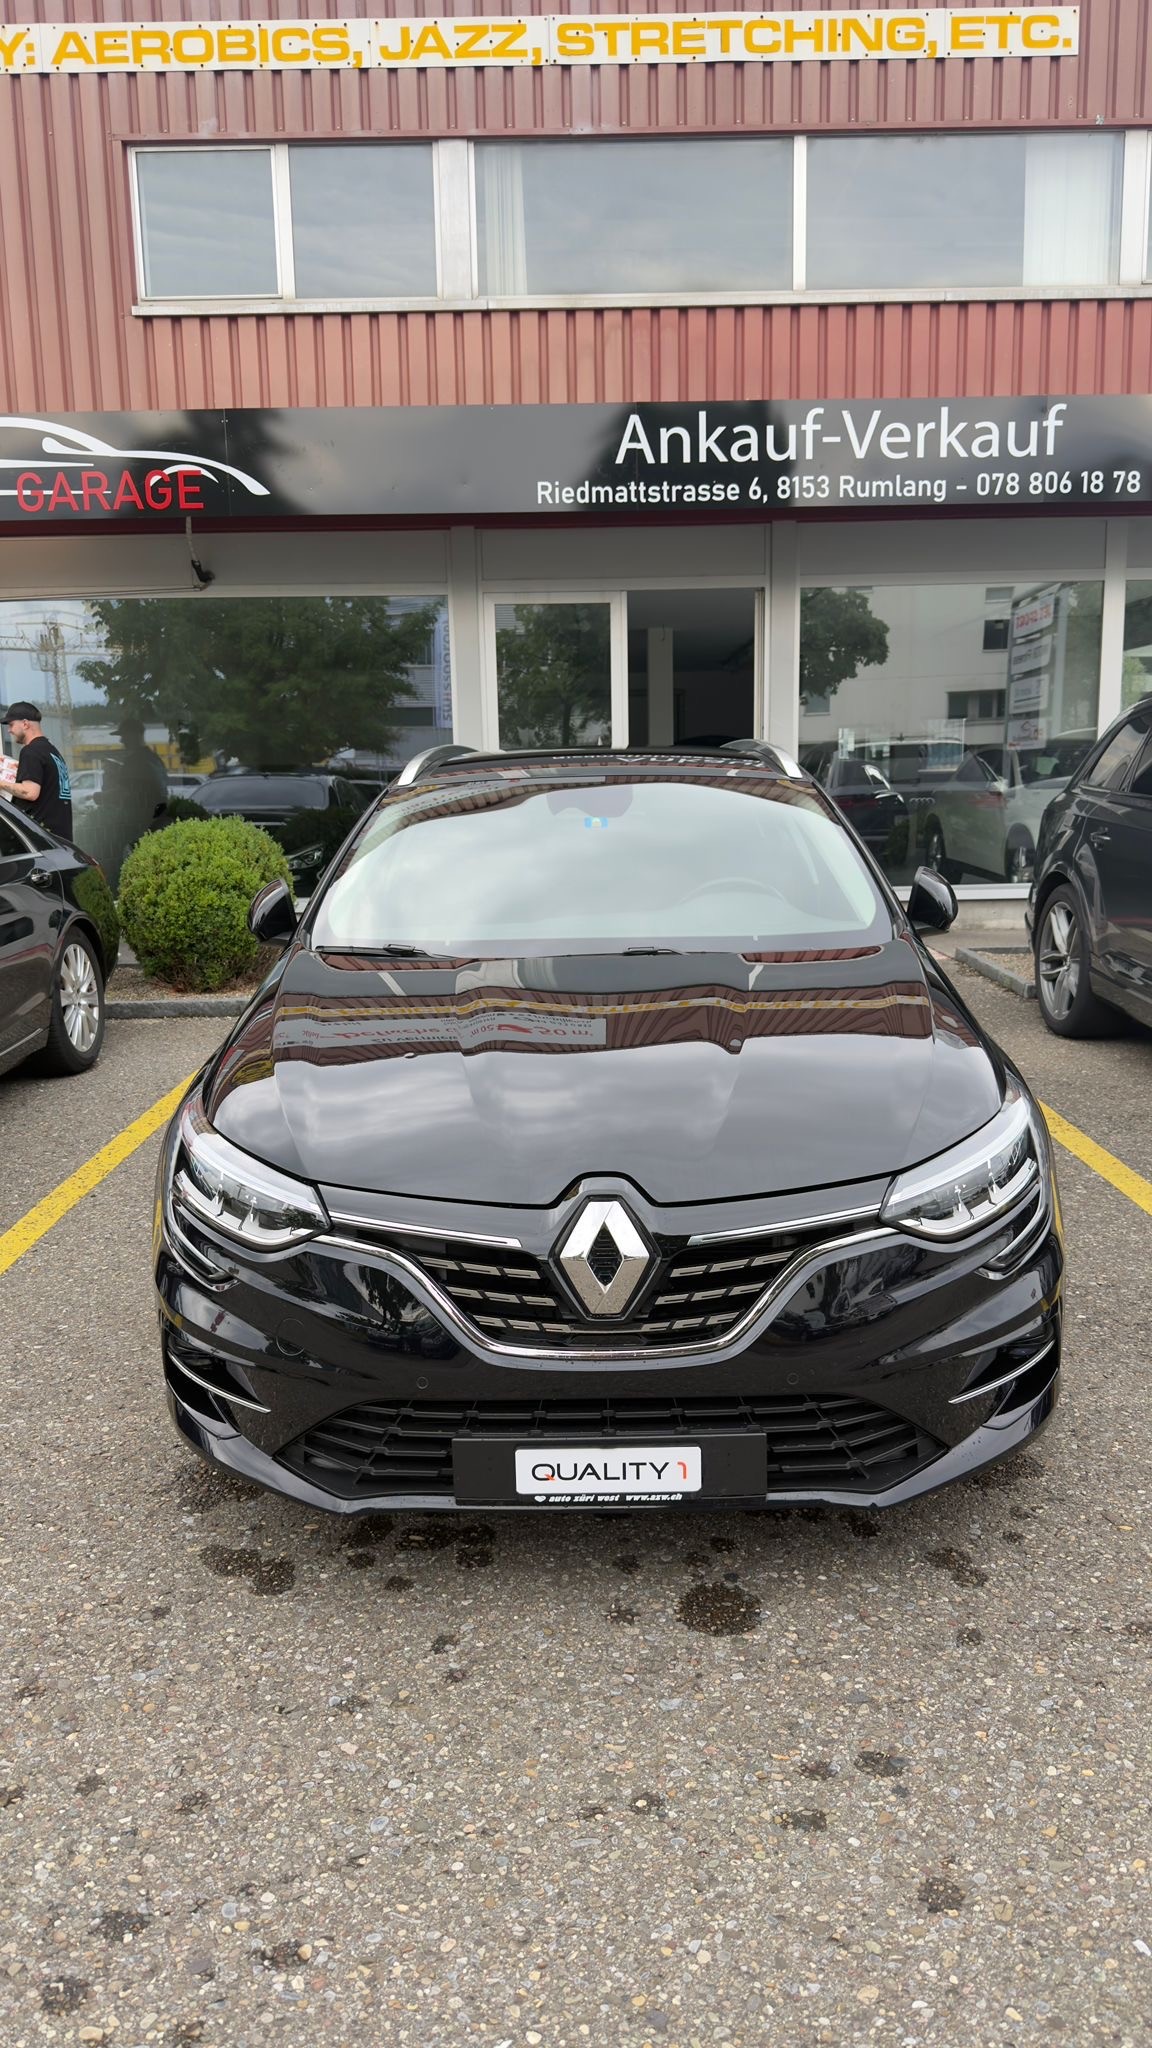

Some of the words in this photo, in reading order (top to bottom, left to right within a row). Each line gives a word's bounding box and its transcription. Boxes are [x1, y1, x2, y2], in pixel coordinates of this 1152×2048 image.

[51, 28, 363, 69] AEROBICS,
[379, 24, 542, 66] JAZZ,
[557, 18, 938, 59] STRETCHING,
[950, 15, 1072, 50] ETC.
[615, 403, 1068, 464] Ankauf-Verkauf
[16, 469, 205, 512] GARAGE
[537, 480, 740, 504] Riedmattstrasse
[748, 477, 769, 503] 6,
[777, 475, 830, 499] 8153
[839, 474, 947, 502] Rumlang
[976, 472, 1020, 496] 078
[1028, 471, 1073, 495] 806
[1081, 471, 1104, 494] 18
[1112, 470, 1142, 494] 78
[531, 1461, 670, 1481] QUALITY
[677, 1461, 687, 1480] 1
